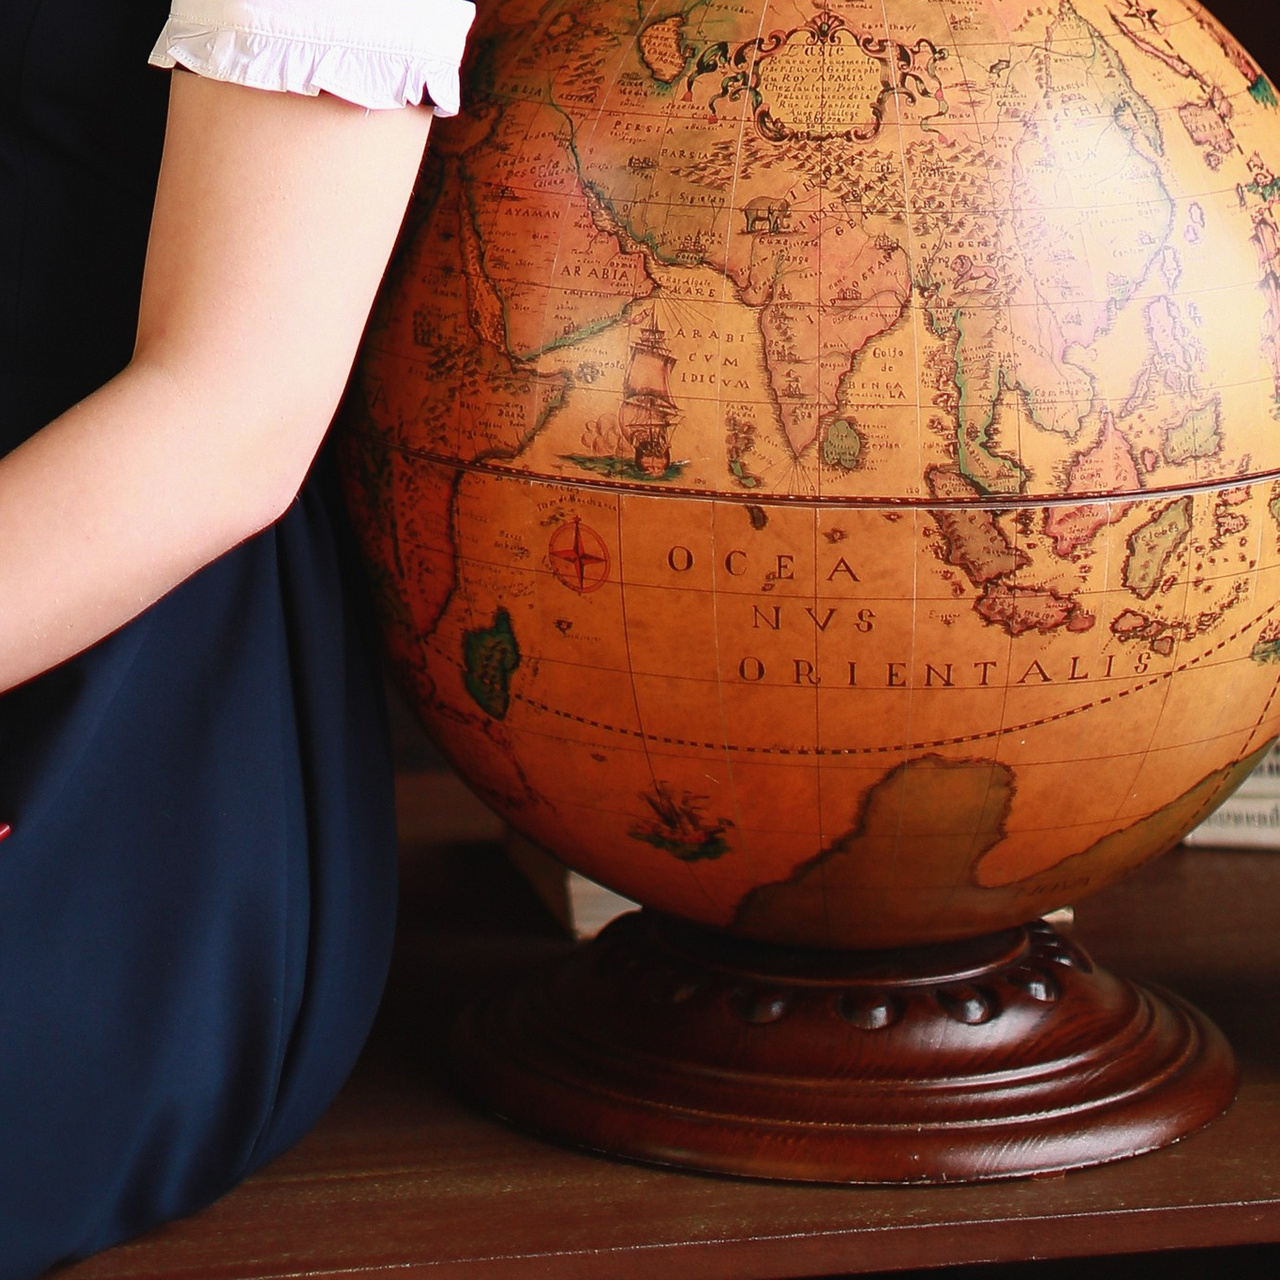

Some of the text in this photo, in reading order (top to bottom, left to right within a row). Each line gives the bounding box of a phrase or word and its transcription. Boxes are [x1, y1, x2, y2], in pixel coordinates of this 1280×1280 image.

[613, 120, 674, 135] PERSIA
[504, 207, 561, 220] AYAMAN
[560, 264, 630, 282] ARABIA
[669, 284, 716, 298] MARE
[674, 327, 746, 343] ARABI
[880, 362, 894, 373] de
[738, 650, 1153, 686] ORIENTALIS
